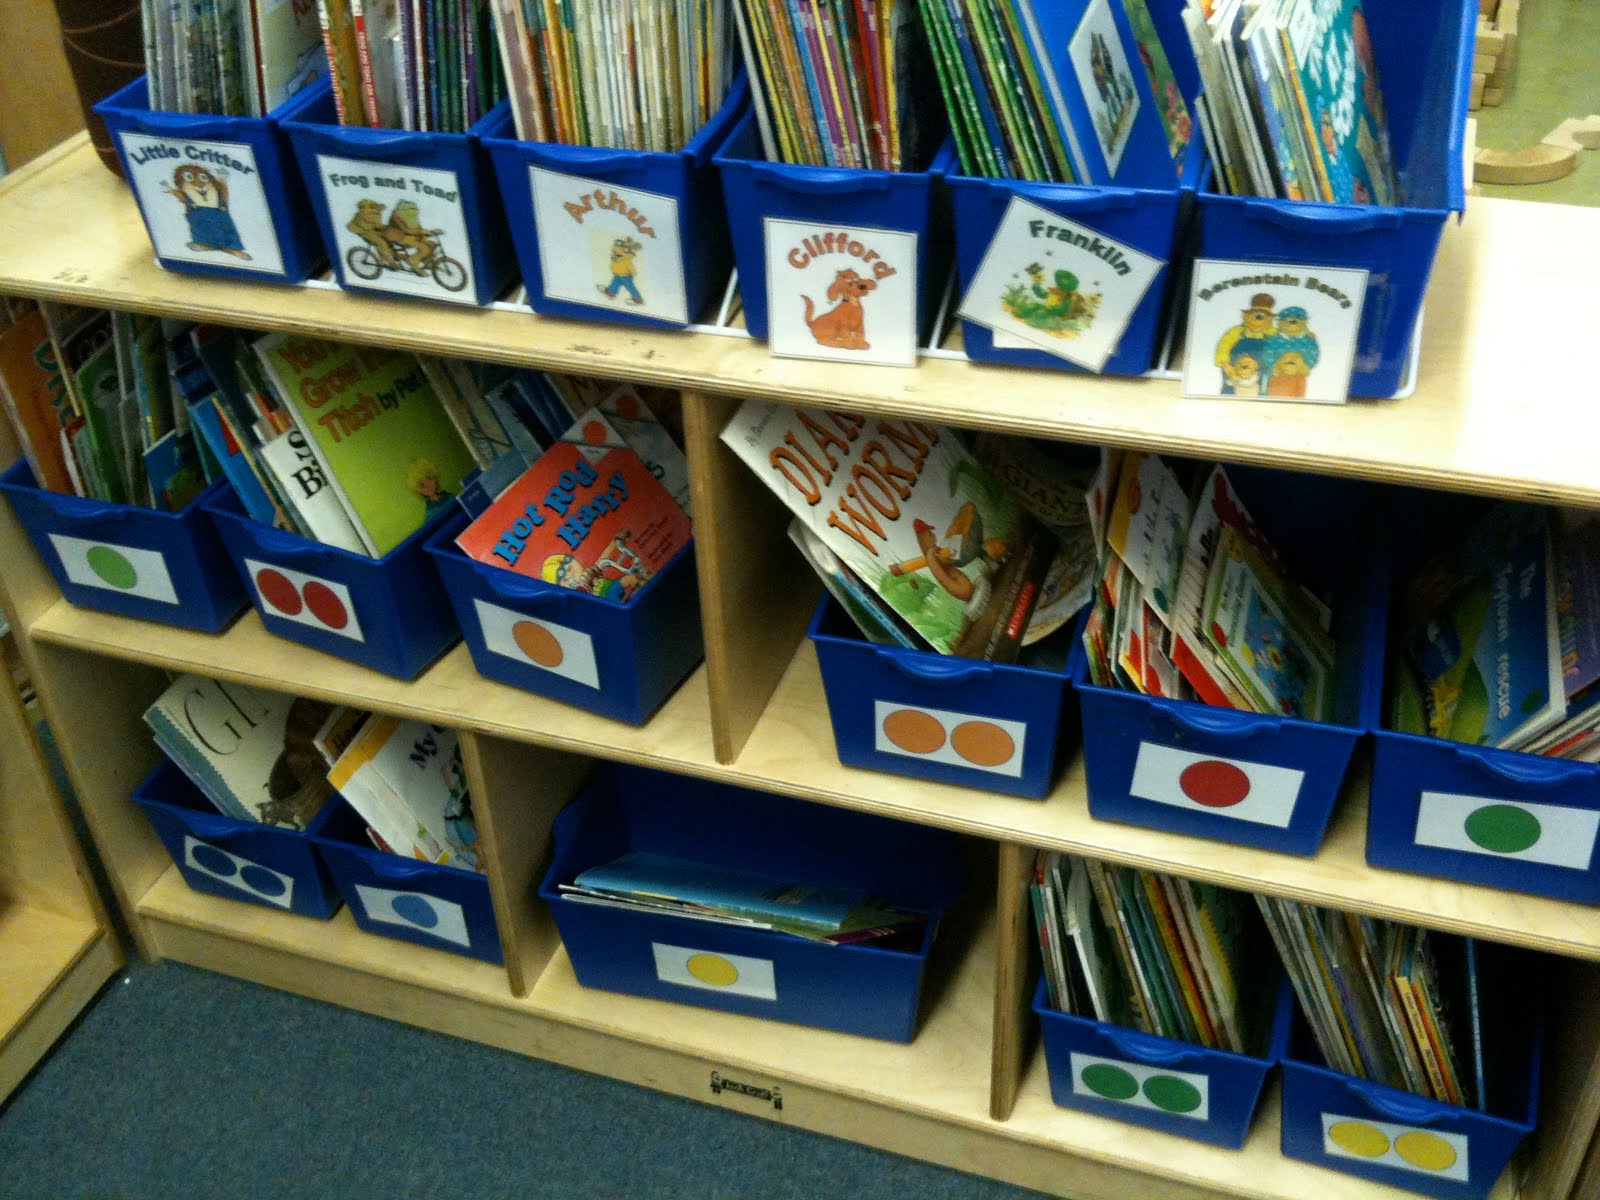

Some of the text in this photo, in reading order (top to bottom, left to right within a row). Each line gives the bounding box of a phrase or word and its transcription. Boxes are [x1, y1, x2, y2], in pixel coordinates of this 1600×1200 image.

[129, 144, 255, 175] Little Critter
[329, 173, 459, 203] Frog and Toad
[563, 188, 656, 239] Arthur
[787, 231, 898, 281] Clifford
[1028, 218, 1133, 277] Franklin
[1199, 273, 1353, 309] Berenstain Bears
[493, 459, 598, 566] Hot Rod
[556, 470, 629, 550] Harry
